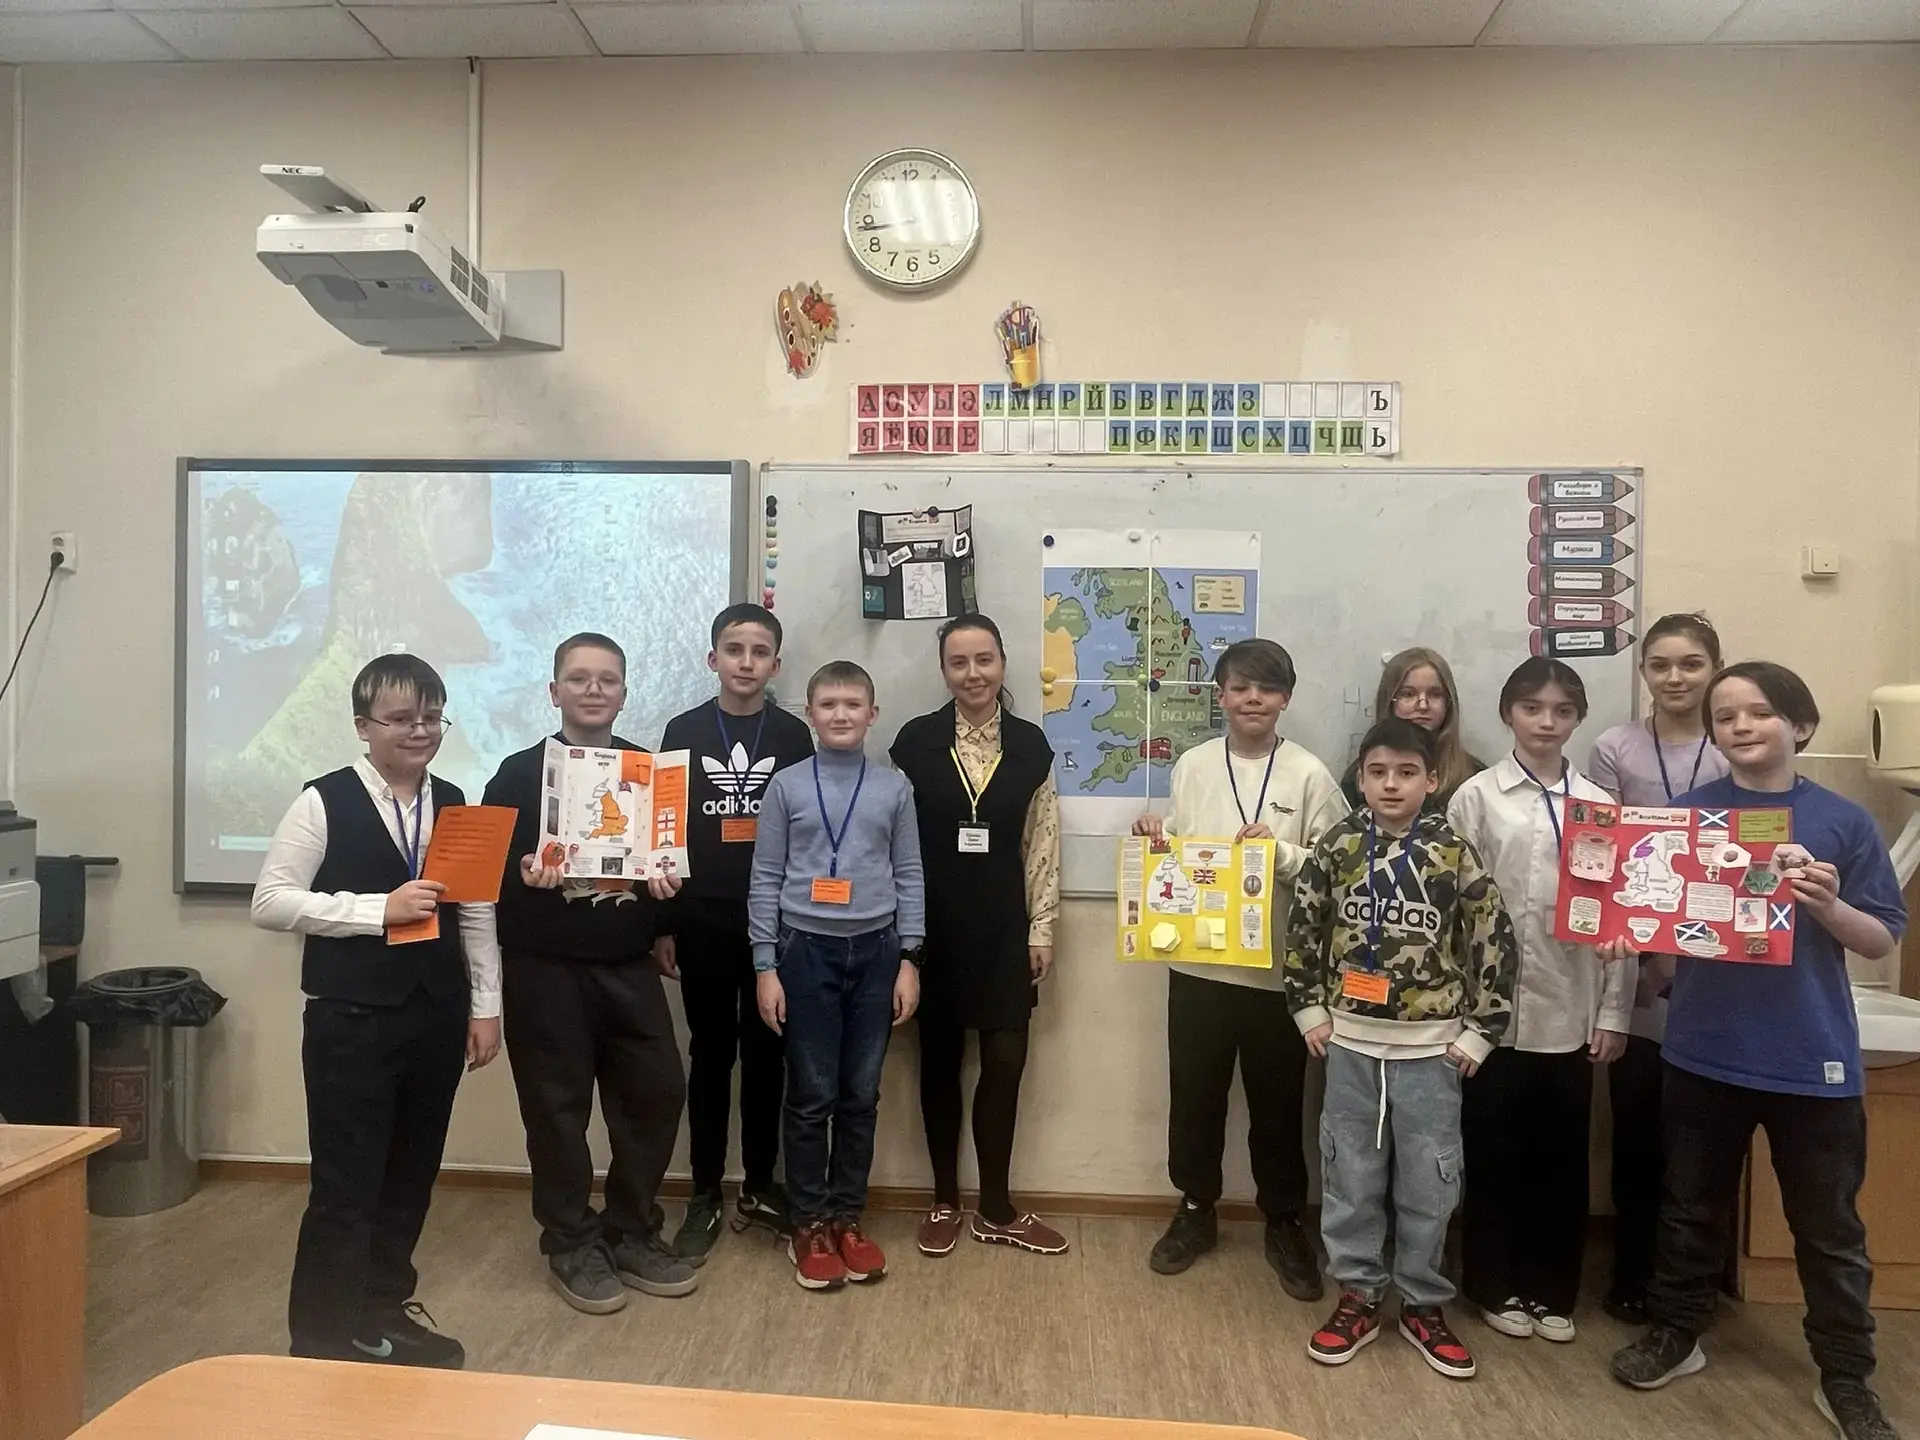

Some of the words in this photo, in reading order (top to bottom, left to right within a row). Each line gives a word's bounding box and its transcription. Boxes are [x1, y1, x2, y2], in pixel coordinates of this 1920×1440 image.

[281, 167, 303, 175] NEC
[869, 237, 881, 253] 8
[887, 252, 898, 267] 7
[907, 256, 919, 272] 6
[928, 250, 940, 265] 5
[1161, 710, 1205, 722] ENGLAND
[702, 795, 761, 815] adida
[1344, 900, 1438, 931] adidas
